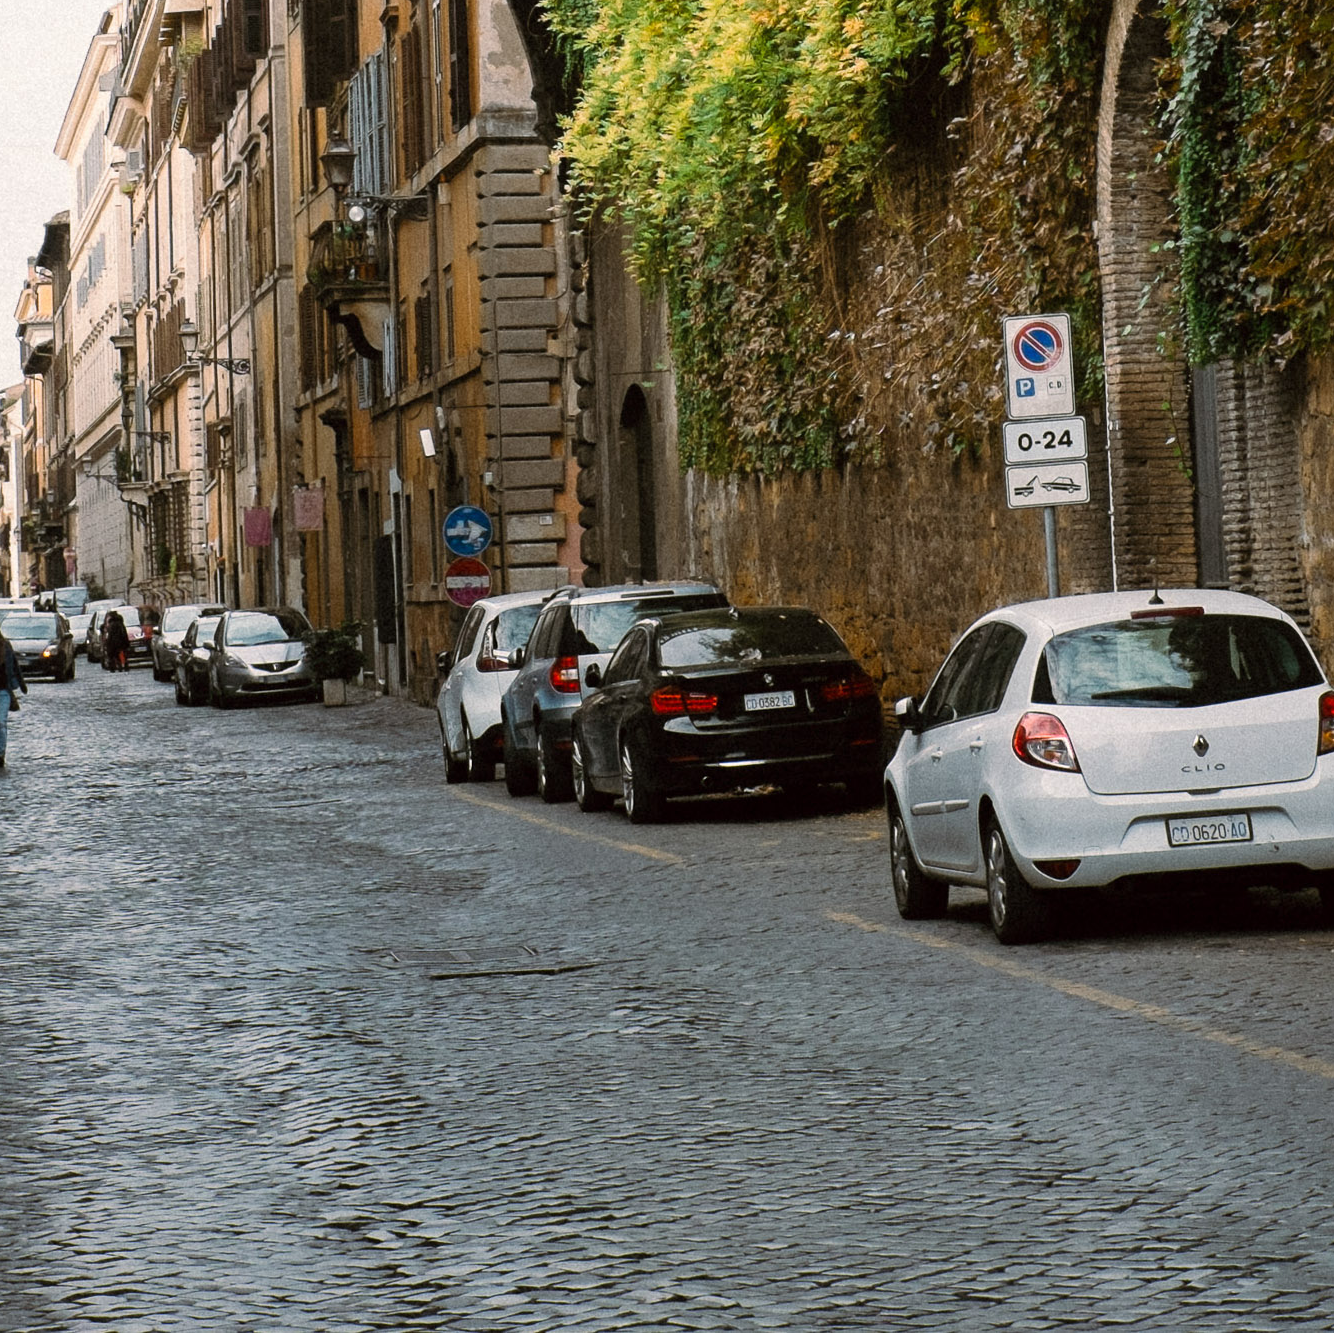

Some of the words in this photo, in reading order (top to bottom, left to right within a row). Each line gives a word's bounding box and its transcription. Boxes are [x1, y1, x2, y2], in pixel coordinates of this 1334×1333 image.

[1019, 379, 1032, 396] P
[1017, 429, 1074, 452] 0-24
[1181, 763, 1226, 773] CLIO
